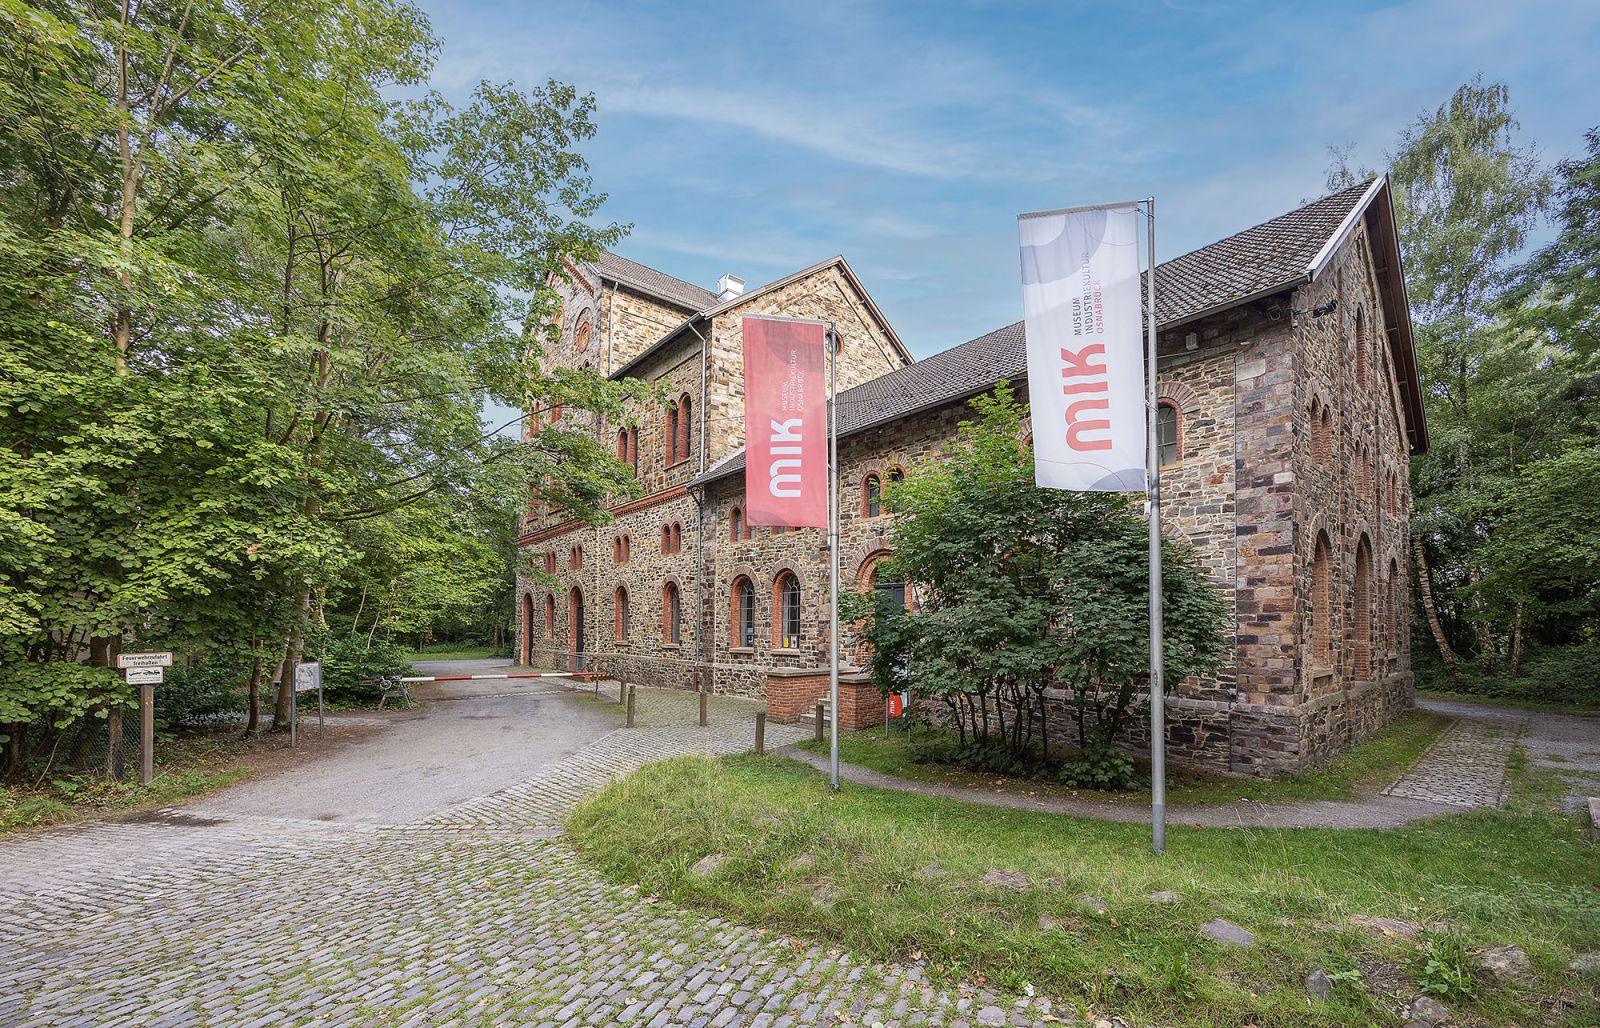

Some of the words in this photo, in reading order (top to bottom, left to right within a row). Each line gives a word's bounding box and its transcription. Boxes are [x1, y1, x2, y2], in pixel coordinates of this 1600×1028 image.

[1072, 297, 1082, 336] MUSEUM
[1081, 252, 1094, 335] INDUSTRIEKULTUR
[789, 350, 797, 411] INDUSTRIEKULTUR
